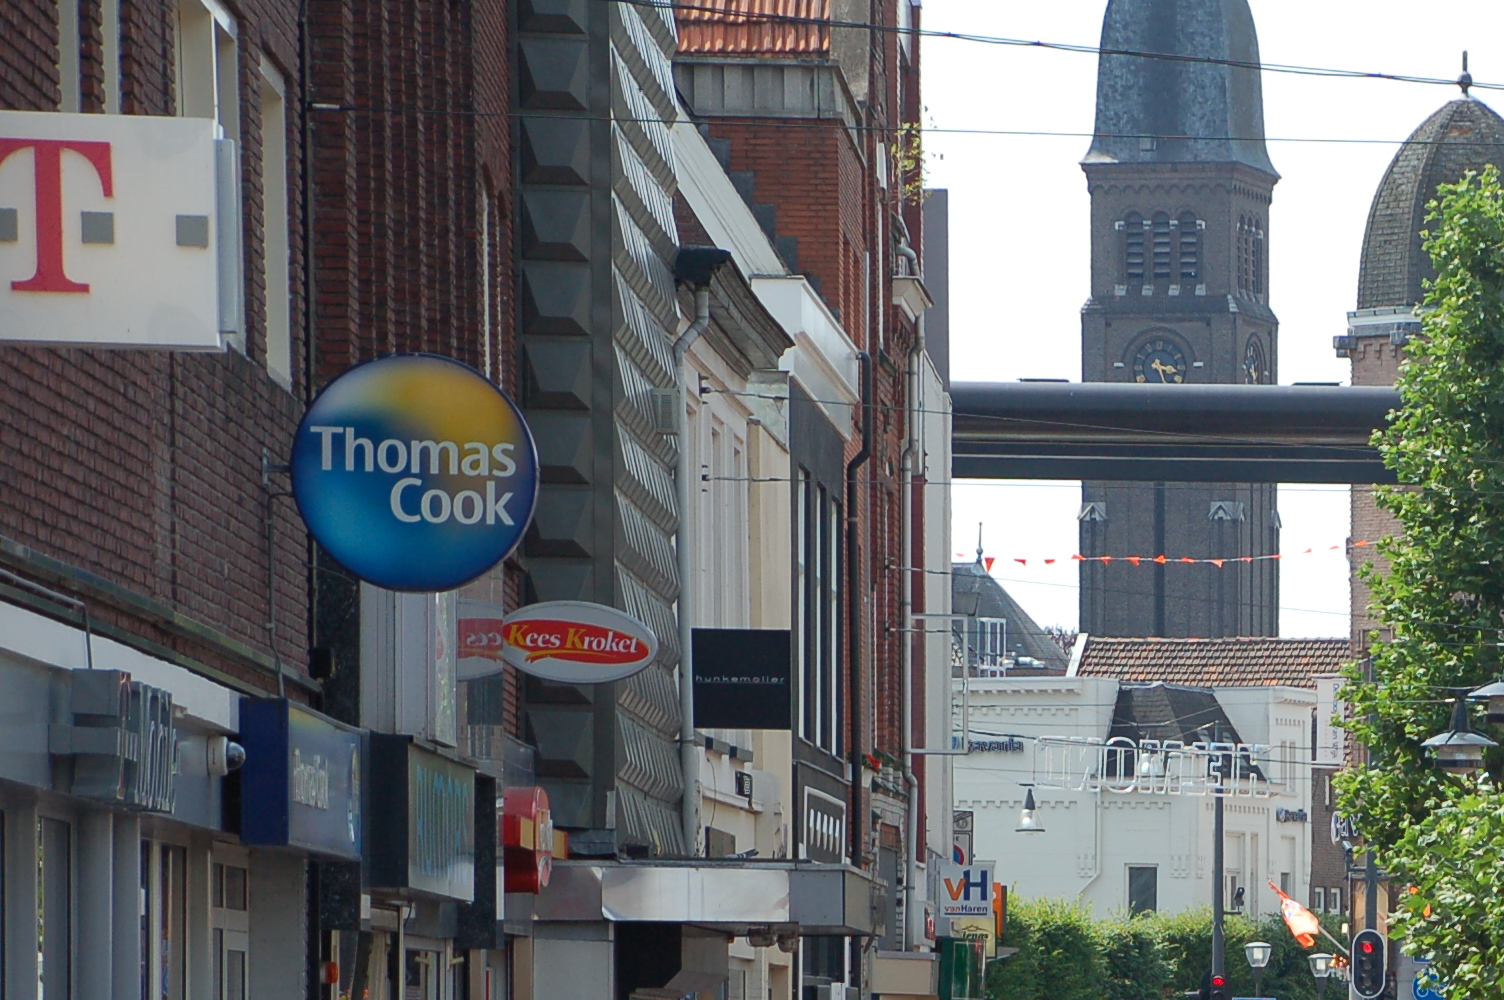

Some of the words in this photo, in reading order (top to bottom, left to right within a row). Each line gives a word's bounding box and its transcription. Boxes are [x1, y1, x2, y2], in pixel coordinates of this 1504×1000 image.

[309, 425, 517, 477] Thomas
[389, 476, 515, 526] Cook
[508, 624, 561, 649] Kees
[564, 627, 639, 653] Kroket
[944, 869, 988, 901] vH
[944, 904, 988, 913] vanHaren
